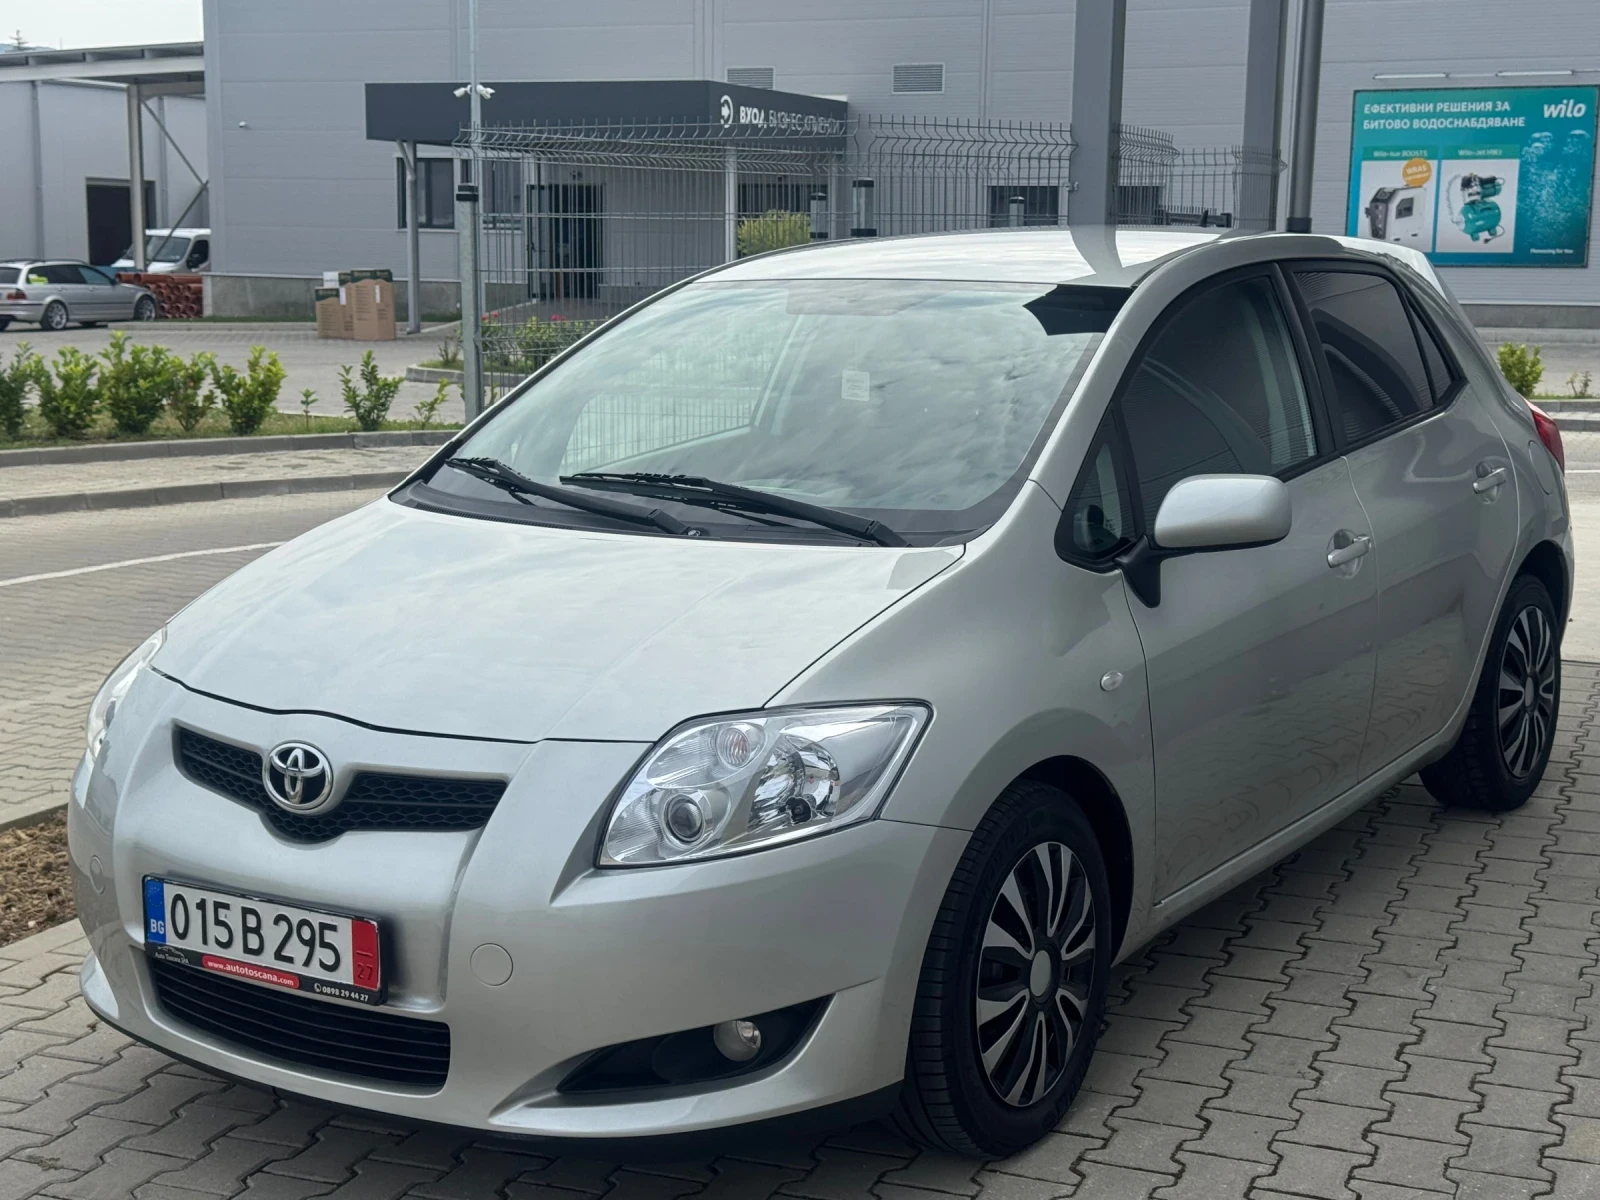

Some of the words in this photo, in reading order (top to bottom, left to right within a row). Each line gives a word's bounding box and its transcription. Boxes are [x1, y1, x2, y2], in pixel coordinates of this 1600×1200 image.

[1363, 102, 1434, 115] ЕФЕКТИВНИ
[1435, 101, 1493, 113] РЕШЕНИЯ
[1495, 100, 1510, 112] ЗА
[1543, 99, 1587, 119] wilo
[1363, 118, 1410, 130] БИТОВО
[1412, 116, 1526, 130] ВОДОСНАБДЯВАНЕ
[150, 919, 165, 935] BG
[207, 959, 294, 986] www.autotoscana.com
[322, 986, 340, 997] 0898
[341, 989, 350, 999] 29
[350, 991, 359, 1001] 44
[360, 993, 369, 1002] 27
